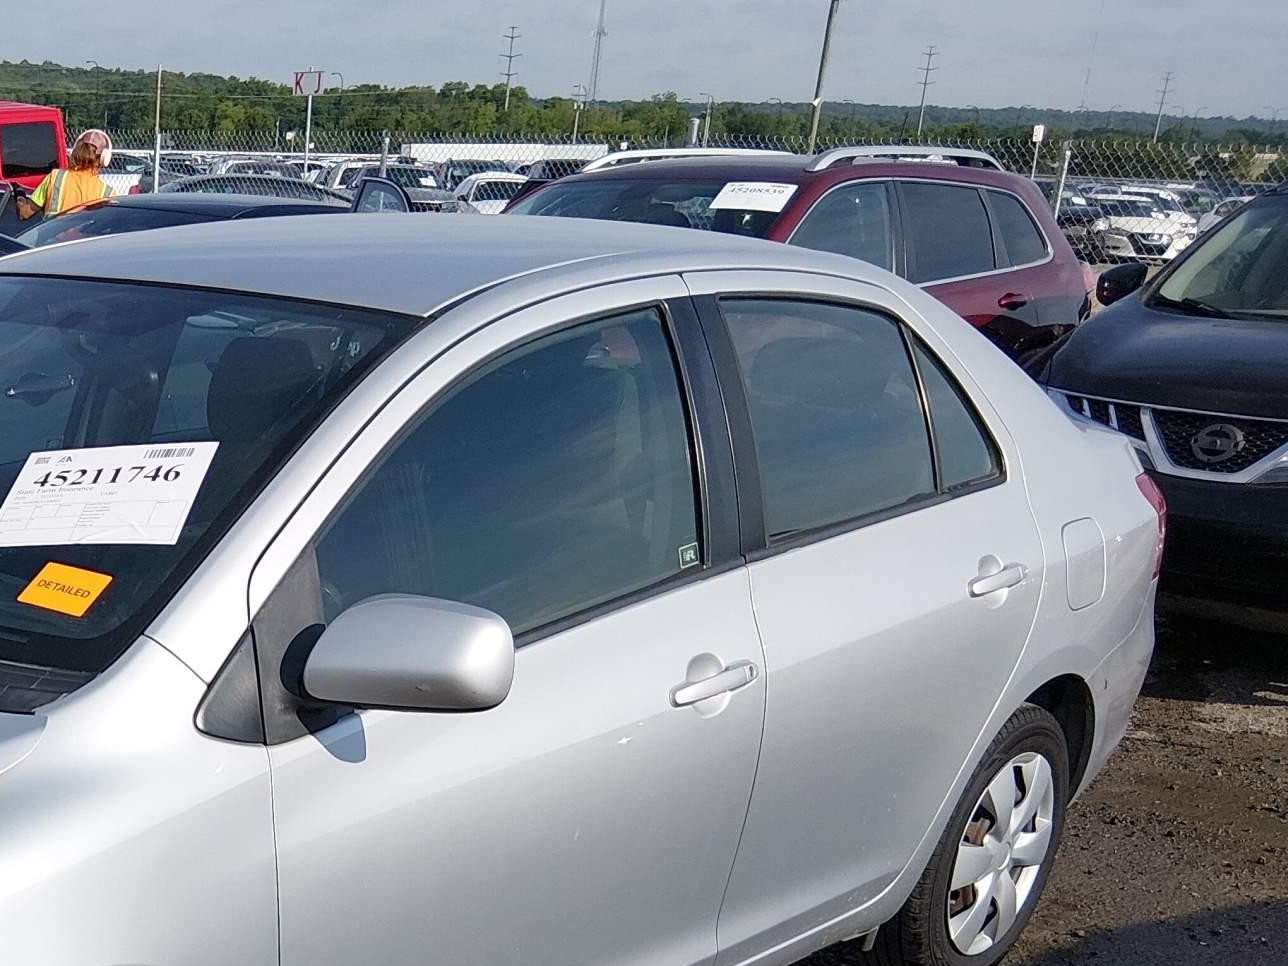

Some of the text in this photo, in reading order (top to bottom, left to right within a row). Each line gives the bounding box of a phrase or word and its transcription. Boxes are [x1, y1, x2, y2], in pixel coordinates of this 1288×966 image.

[294, 71, 322, 95] K J
[33, 464, 186, 488] 45211746
[37, 578, 91, 599] DETAILED
